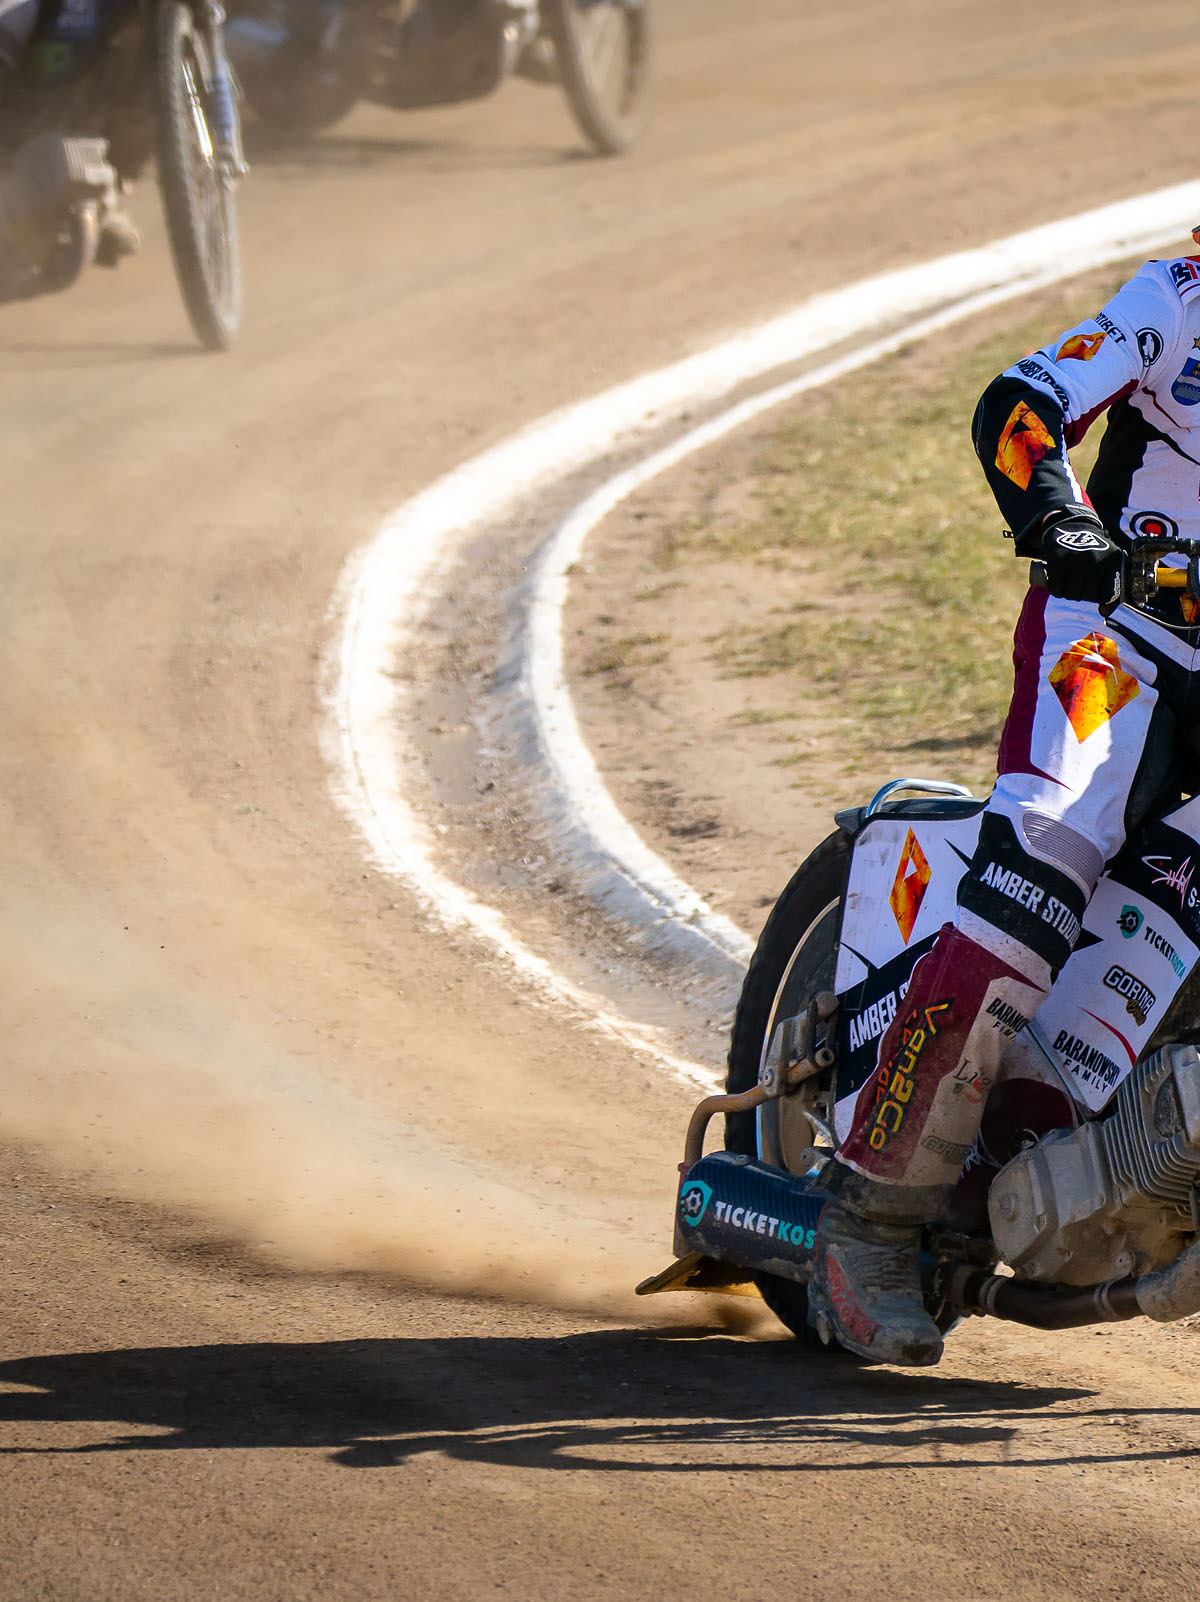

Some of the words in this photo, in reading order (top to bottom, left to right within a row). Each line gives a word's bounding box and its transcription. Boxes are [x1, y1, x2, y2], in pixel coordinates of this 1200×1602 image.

[980, 861, 1045, 914] AMBER
[850, 991, 898, 1053] AMBER
[1053, 1029, 1121, 1088] BARANOWSKI
[1063, 1060, 1109, 1093] FAMILY
[715, 1200, 816, 1249] TICKETKOS
